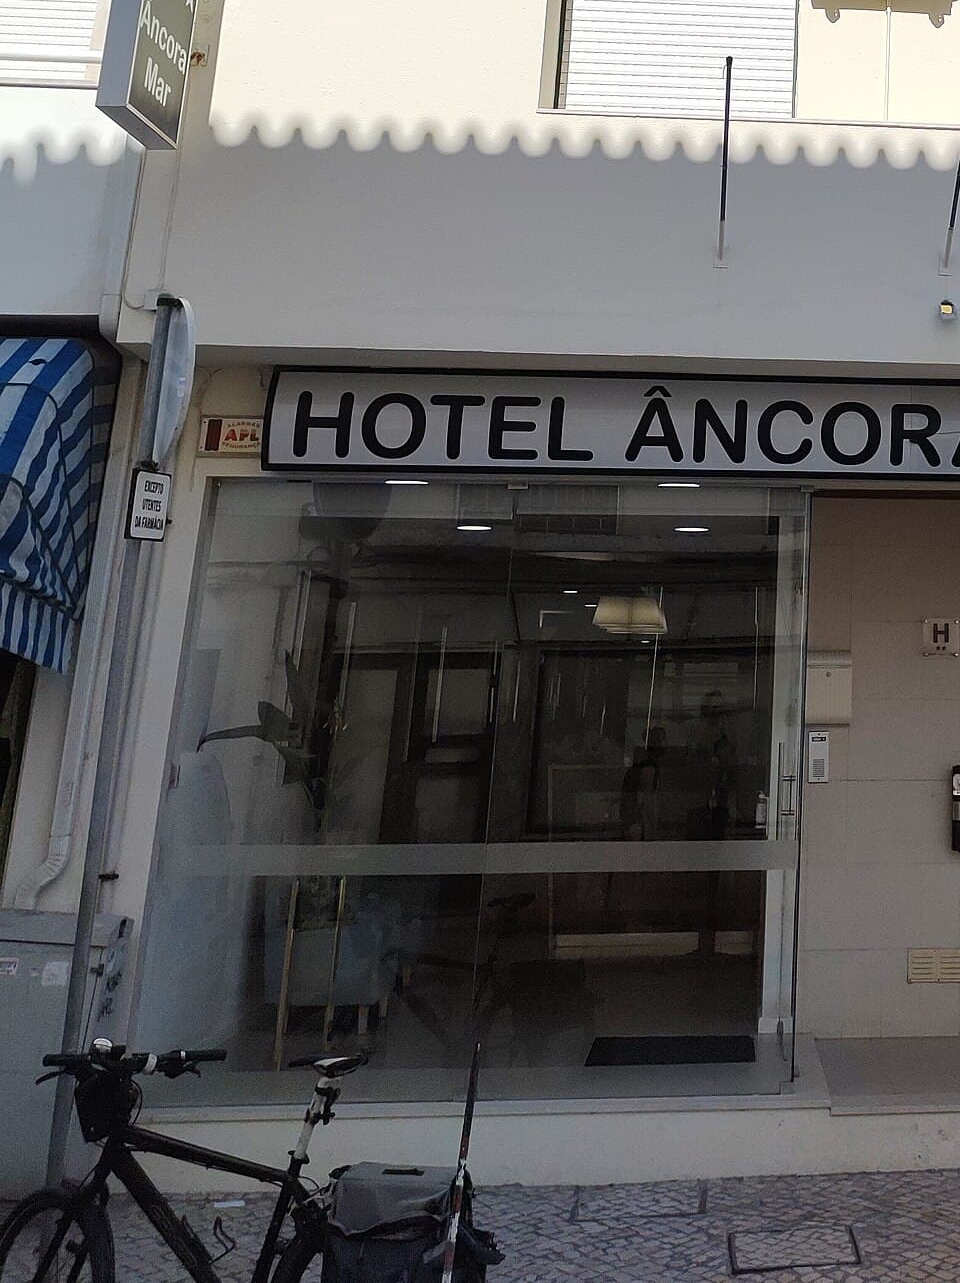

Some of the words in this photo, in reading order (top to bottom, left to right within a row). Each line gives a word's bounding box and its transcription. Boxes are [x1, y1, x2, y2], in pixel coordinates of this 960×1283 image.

[144, 57, 171, 107] Mar
[224, 428, 260, 442] APL
[293, 390, 594, 461] HOTEL
[142, 498, 162, 513] UTENTES
[933, 622, 950, 643] H
